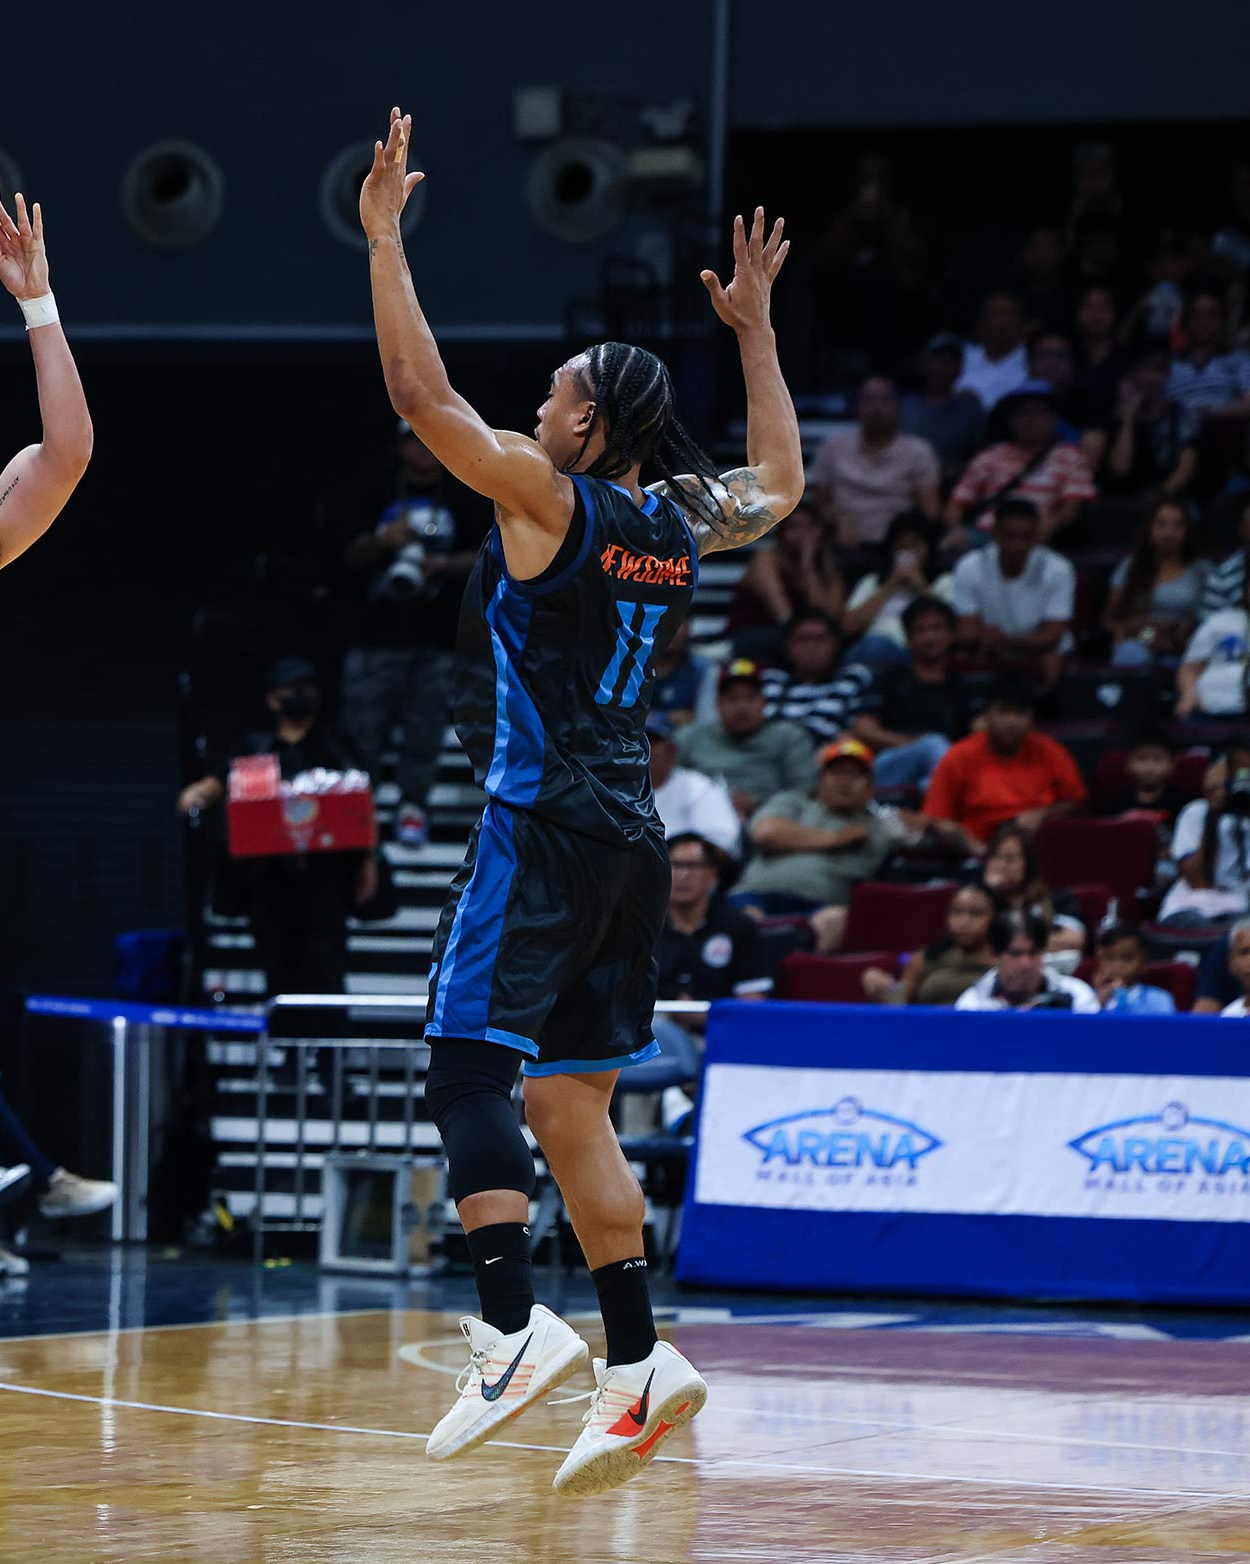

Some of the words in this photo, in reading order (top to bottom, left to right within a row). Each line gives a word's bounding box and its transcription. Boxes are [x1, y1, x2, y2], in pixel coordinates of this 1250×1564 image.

[594, 600, 668, 708] 11
[762, 1129, 918, 1169] ARENA
[1089, 1137, 1250, 1175] ARENA
